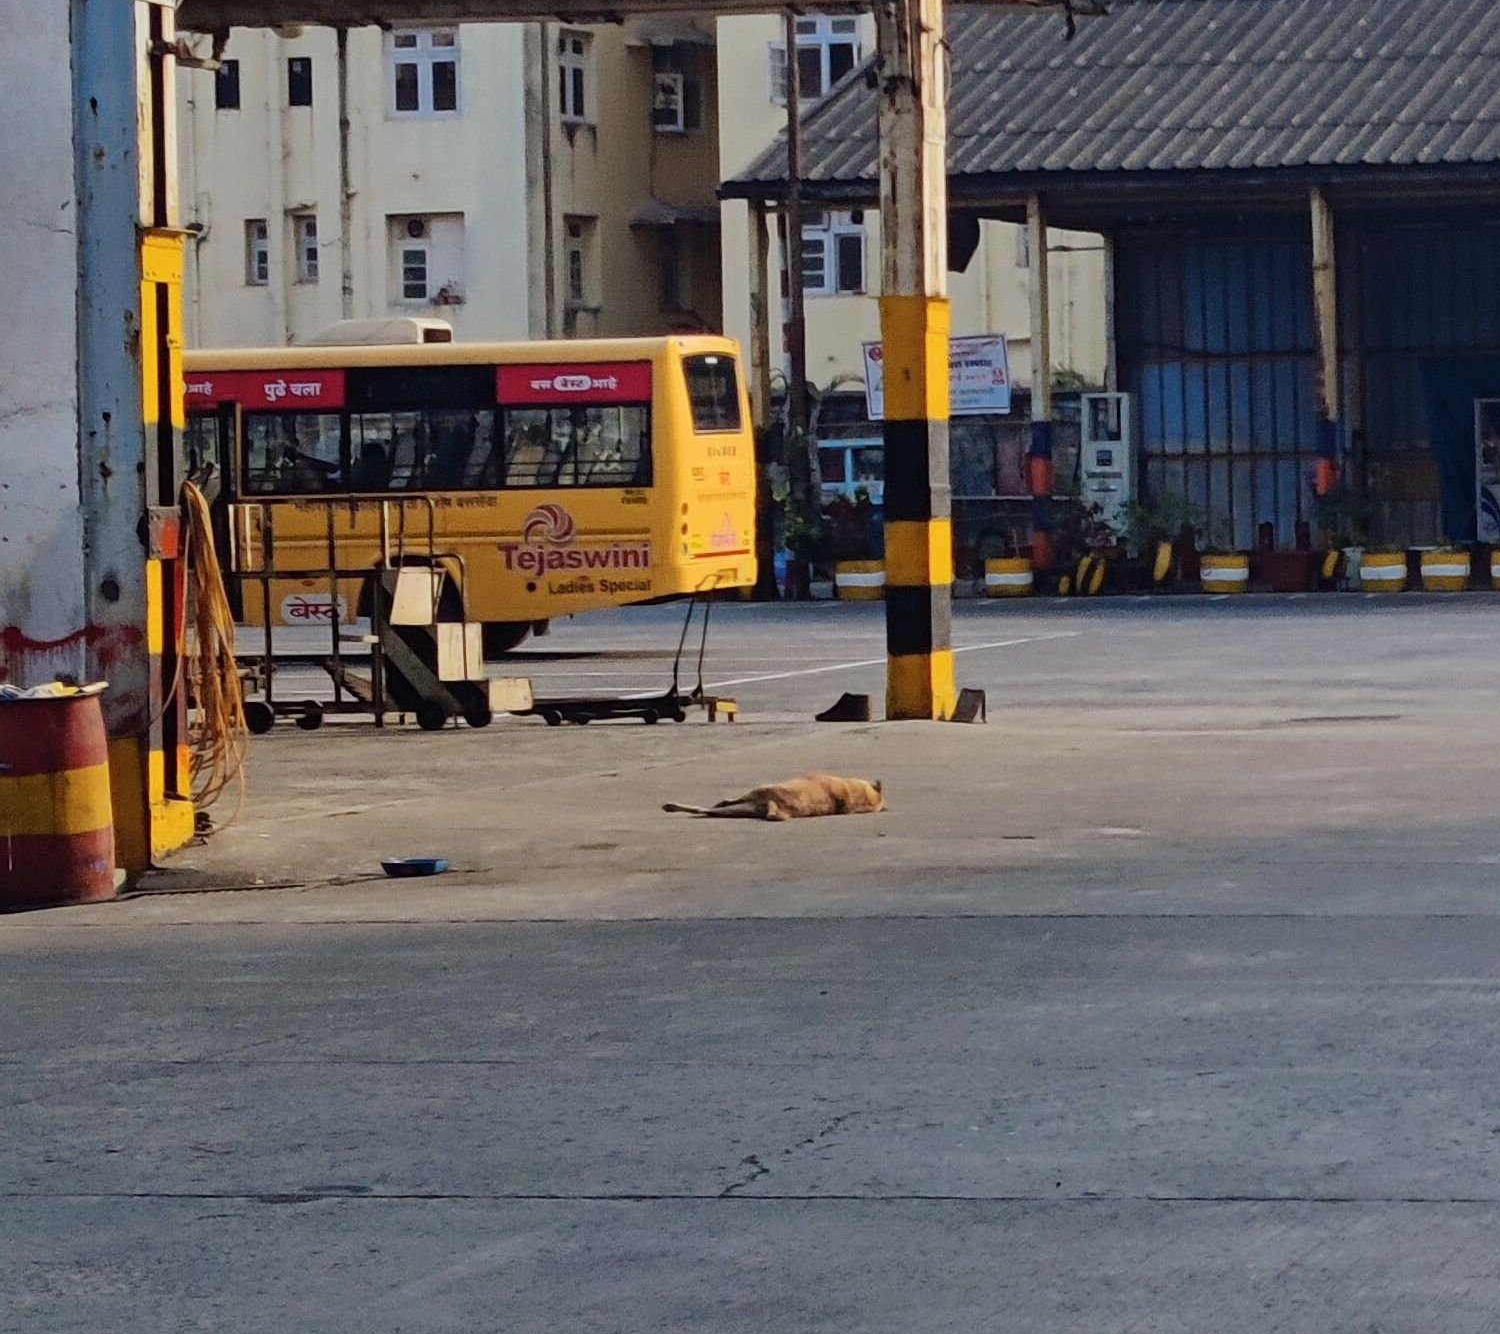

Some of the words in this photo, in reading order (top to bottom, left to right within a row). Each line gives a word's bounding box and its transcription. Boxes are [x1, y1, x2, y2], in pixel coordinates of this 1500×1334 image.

[188, 380, 213, 396] आहे
[264, 379, 287, 402] पुढे
[290, 382, 322, 397] चला
[591, 375, 618, 390] आहे
[497, 543, 650, 577] Tejaswini
[548, 580, 595, 595] Ladies
[600, 578, 652, 595] Special
